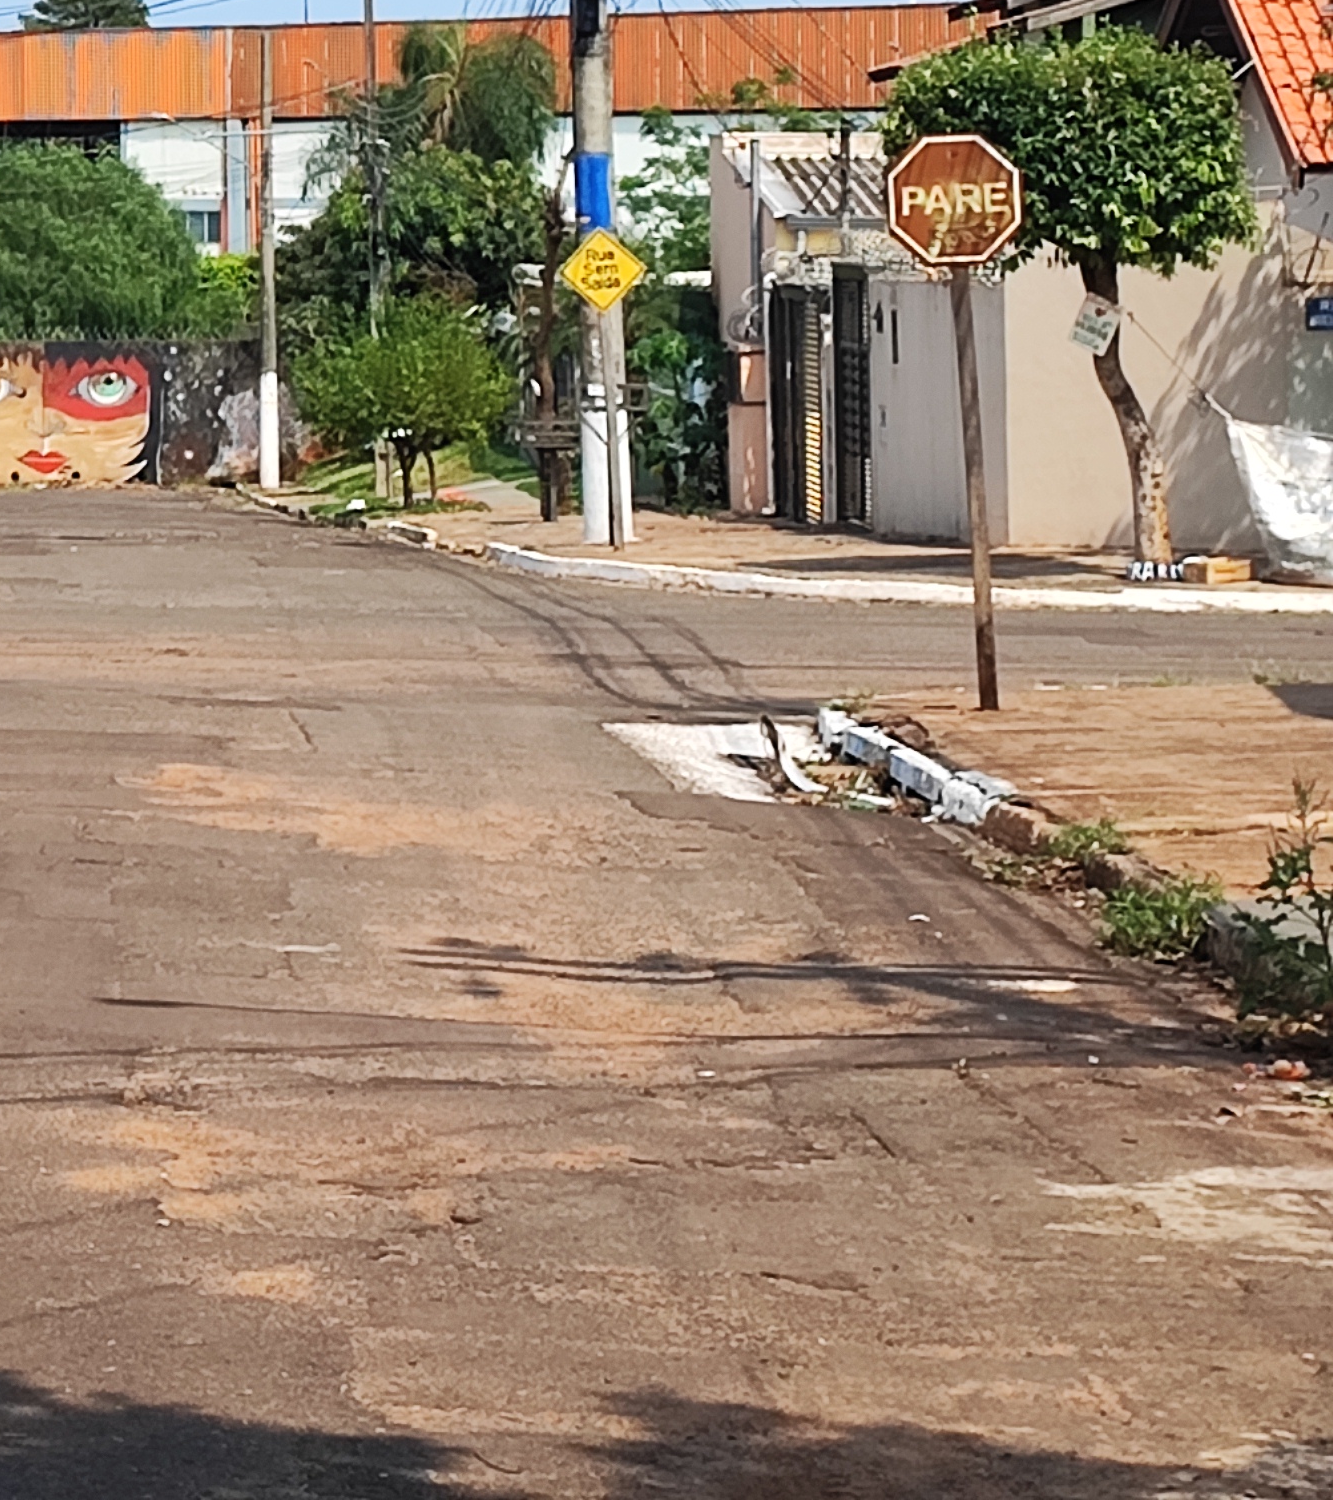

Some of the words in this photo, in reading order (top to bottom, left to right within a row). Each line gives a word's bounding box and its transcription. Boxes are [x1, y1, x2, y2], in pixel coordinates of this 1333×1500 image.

[901, 181, 1008, 217] PARE
[586, 249, 615, 261] Rua
[583, 262, 619, 276] Sem
